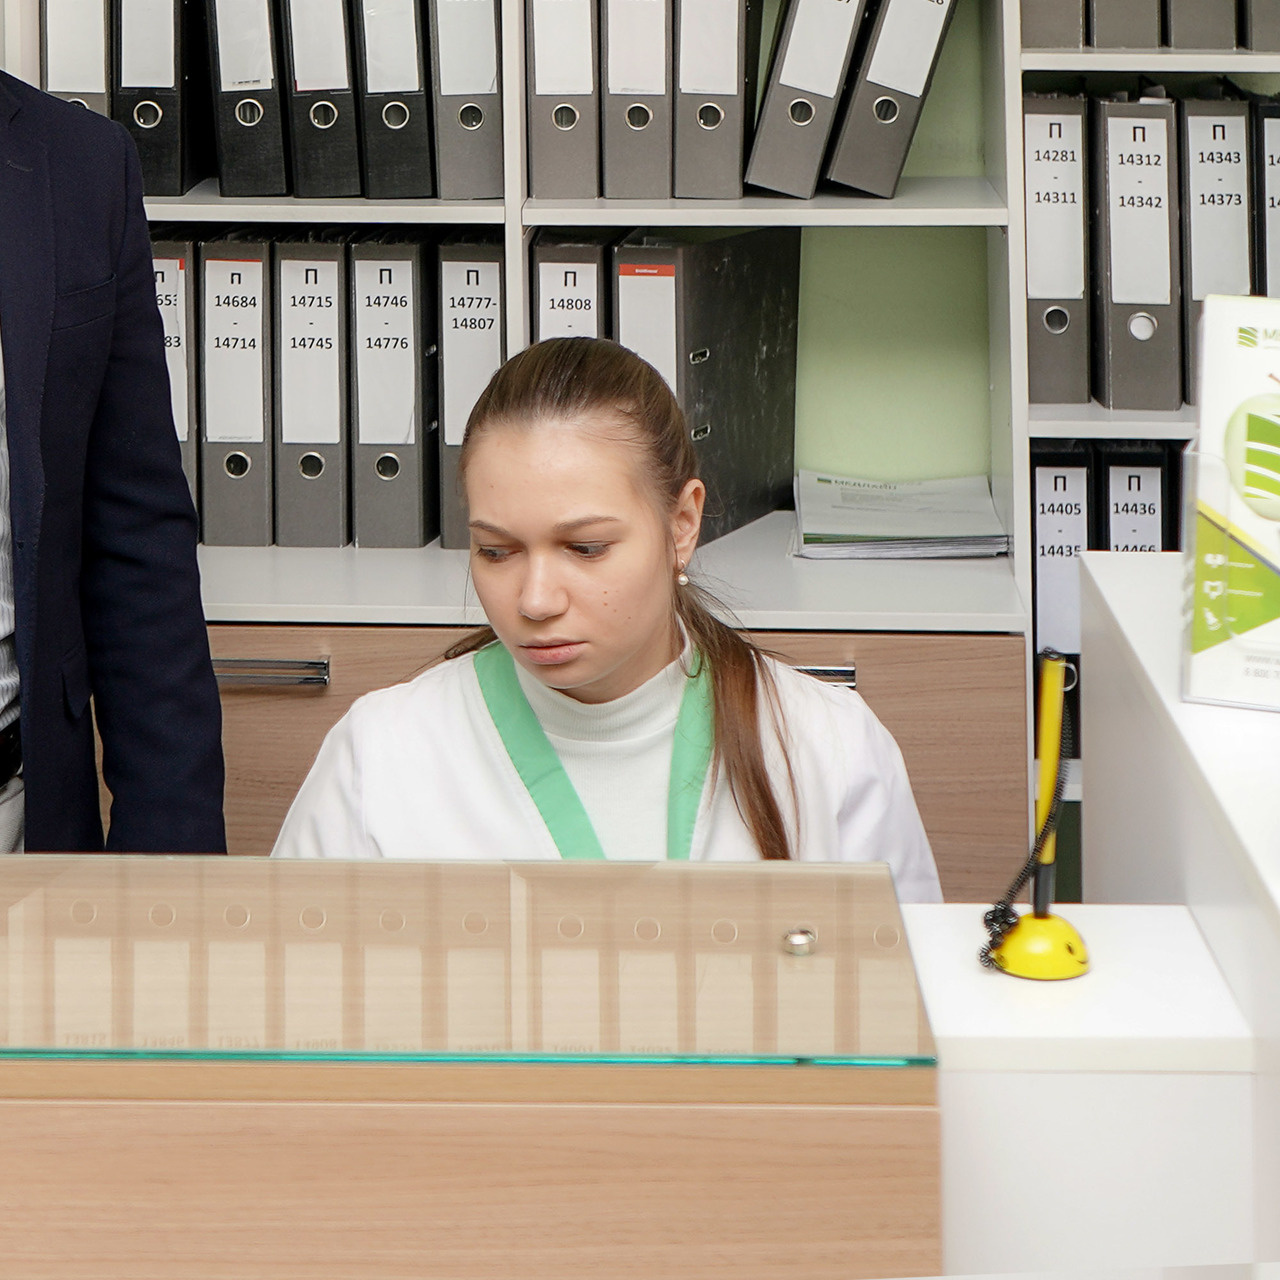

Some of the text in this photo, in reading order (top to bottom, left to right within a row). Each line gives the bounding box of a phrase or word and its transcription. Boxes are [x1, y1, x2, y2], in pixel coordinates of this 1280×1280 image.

[1035, 150, 1076, 162] 14281
[1119, 154, 1161, 166] 14312
[1200, 152, 1240, 163] 14343
[1036, 192, 1076, 204] 14311
[1120, 196, 1161, 208] 14342
[1200, 194, 1241, 205] 14373
[216, 295, 256, 307] 14684
[291, 296, 332, 307] 14715
[366, 296, 407, 307] 14746
[450, 297, 496, 308] 14777-
[550, 299, 591, 310] 14808
[453, 318, 494, 329] 14807
[215, 337, 256, 349] 14714
[291, 337, 332, 349] 14745
[367, 338, 408, 349] 14776
[1054, 476, 1066, 491] П
[1128, 475, 1140, 491] П
[1040, 503, 1081, 515] 14405
[1114, 503, 1155, 515] 14436
